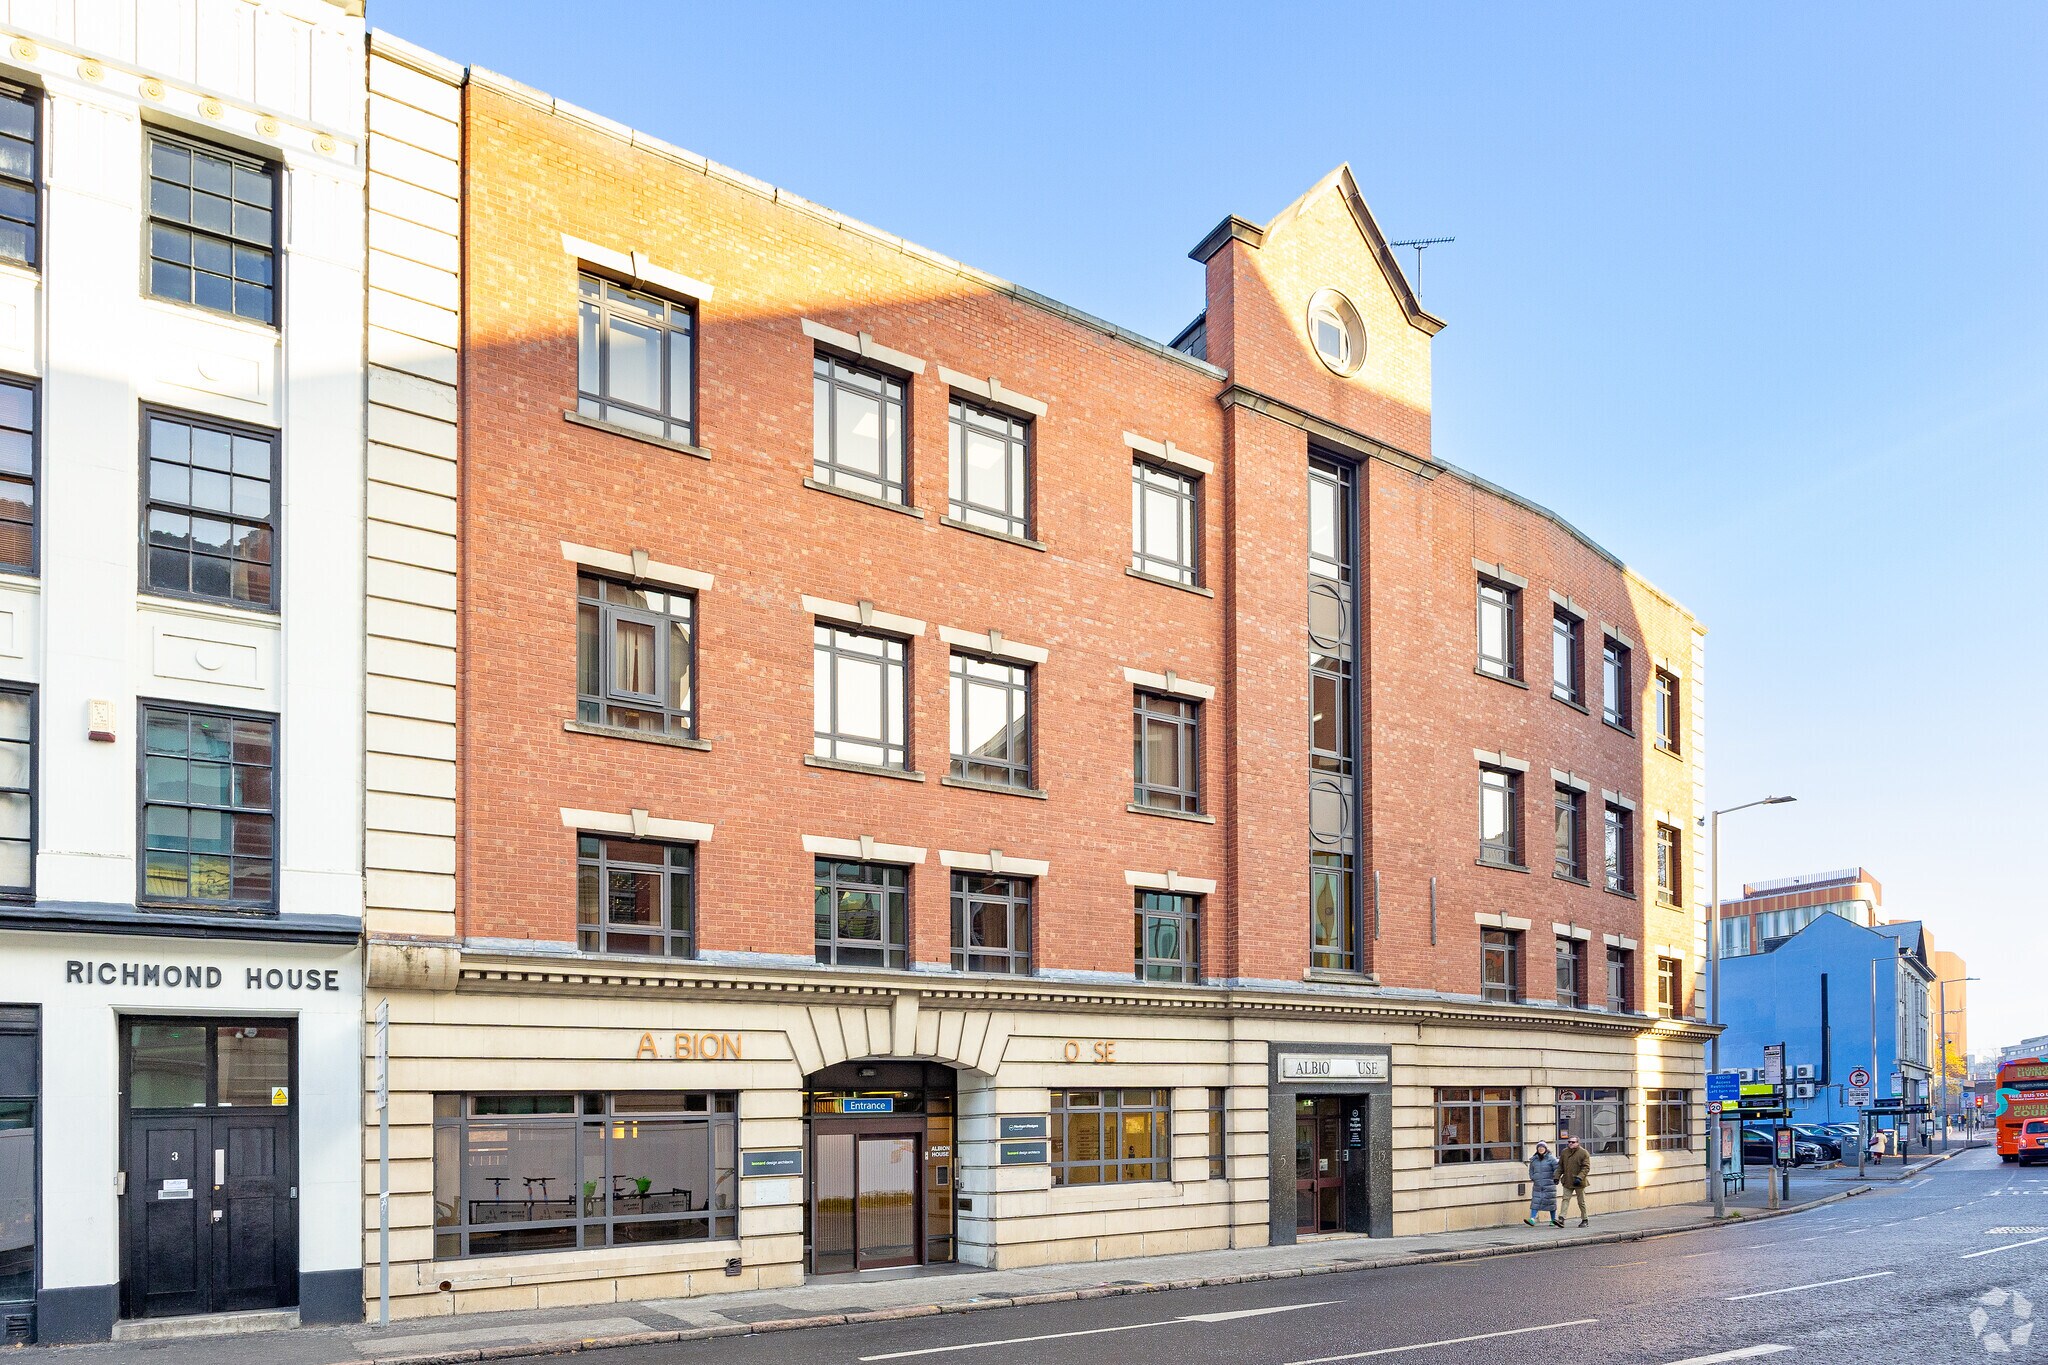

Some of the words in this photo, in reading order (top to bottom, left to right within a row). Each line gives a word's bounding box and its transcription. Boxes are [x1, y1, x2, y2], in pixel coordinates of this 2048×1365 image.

[66, 960, 222, 988] RICHMOND
[246, 967, 339, 991] HOUSE
[637, 1032, 742, 1059] ABION
[1064, 1040, 1116, 1063] OSE
[1296, 1061, 1330, 1075] ALBIO
[1357, 1061, 1378, 1075] USE
[850, 1101, 886, 1110] Entrance
[171, 1151, 179, 1161] 3
